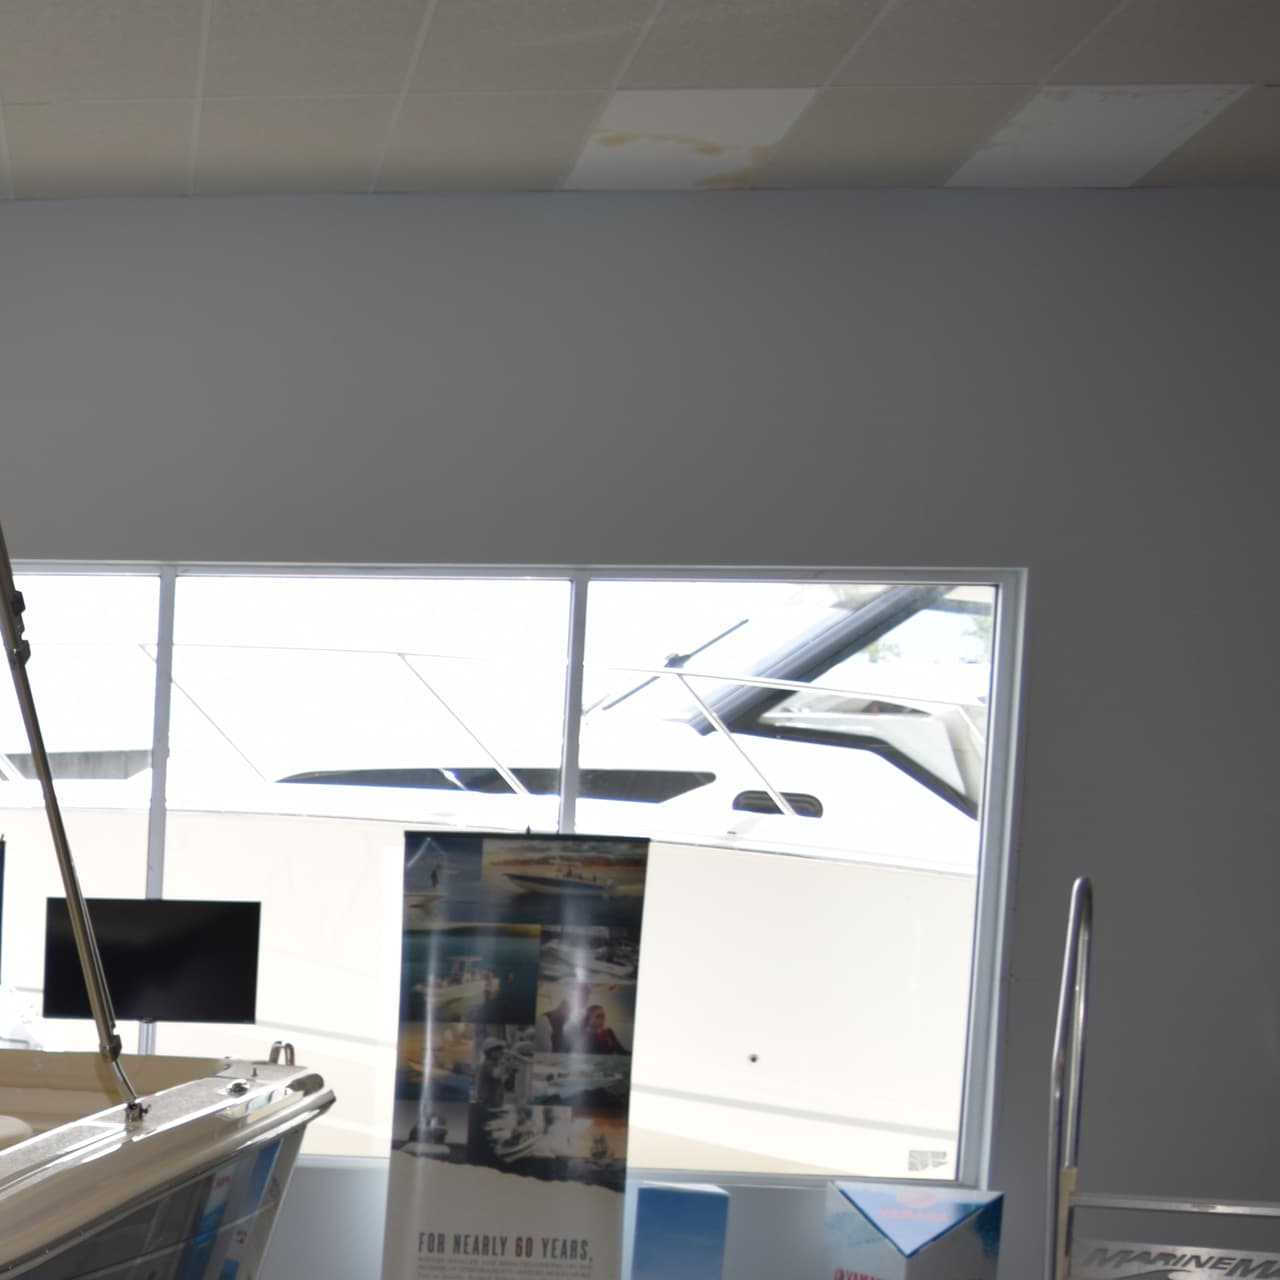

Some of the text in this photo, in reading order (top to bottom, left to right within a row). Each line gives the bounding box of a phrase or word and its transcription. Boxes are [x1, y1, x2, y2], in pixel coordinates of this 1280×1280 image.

[418, 1232, 592, 1262] FOR NEARLY 60 YEARS,
[1081, 1247, 1280, 1280] MARINEM
